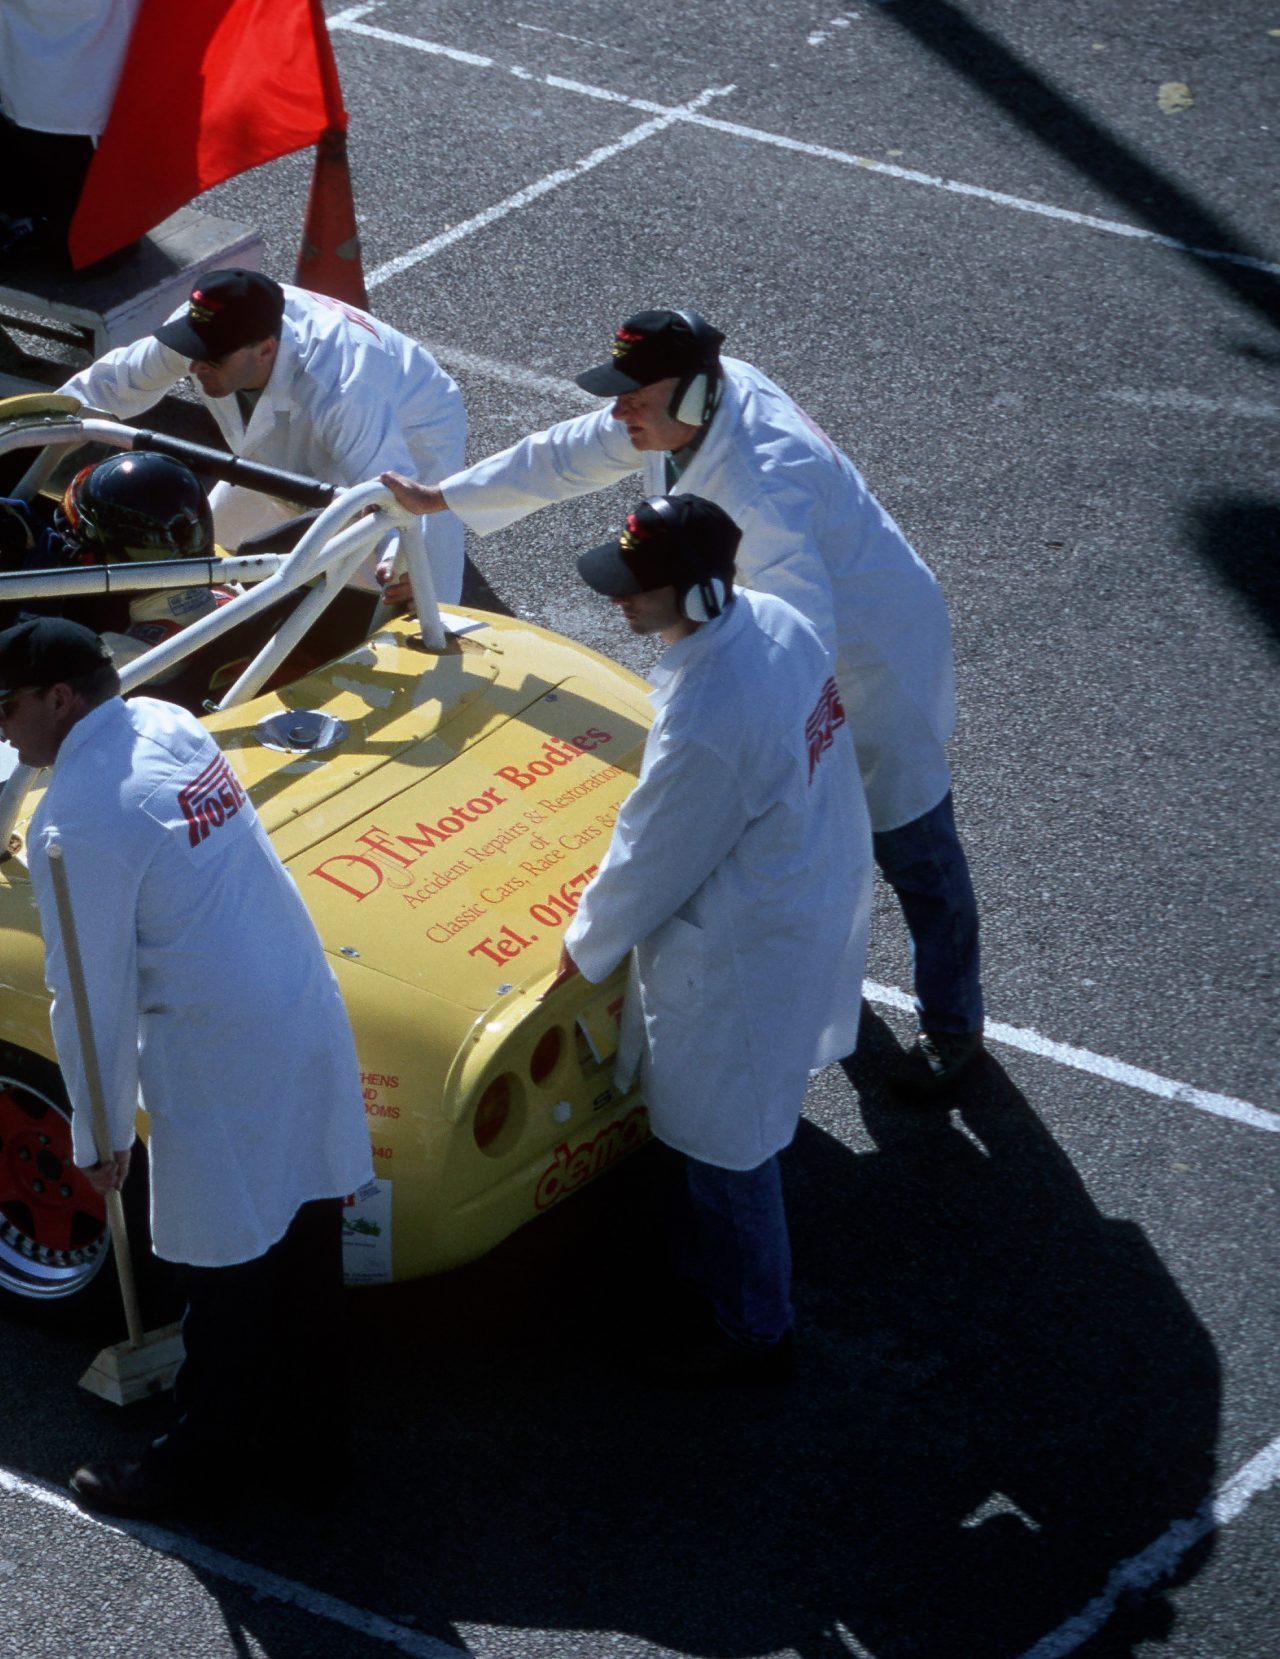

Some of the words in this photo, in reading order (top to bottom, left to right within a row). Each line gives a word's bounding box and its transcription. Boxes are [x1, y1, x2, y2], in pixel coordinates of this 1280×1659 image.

[494, 726, 614, 791] Bodies
[402, 860, 472, 909] Accident
[464, 821, 530, 863] Repairs
[523, 810, 548, 824] &
[530, 831, 550, 850] of
[426, 903, 487, 943] Classic
[480, 877, 531, 904] Cars,
[518, 849, 566, 877] Race
[558, 825, 602, 854] Cars
[467, 925, 539, 967] Tel.
[360, 1072, 399, 1088] HENS
[535, 1106, 653, 1210] demo
